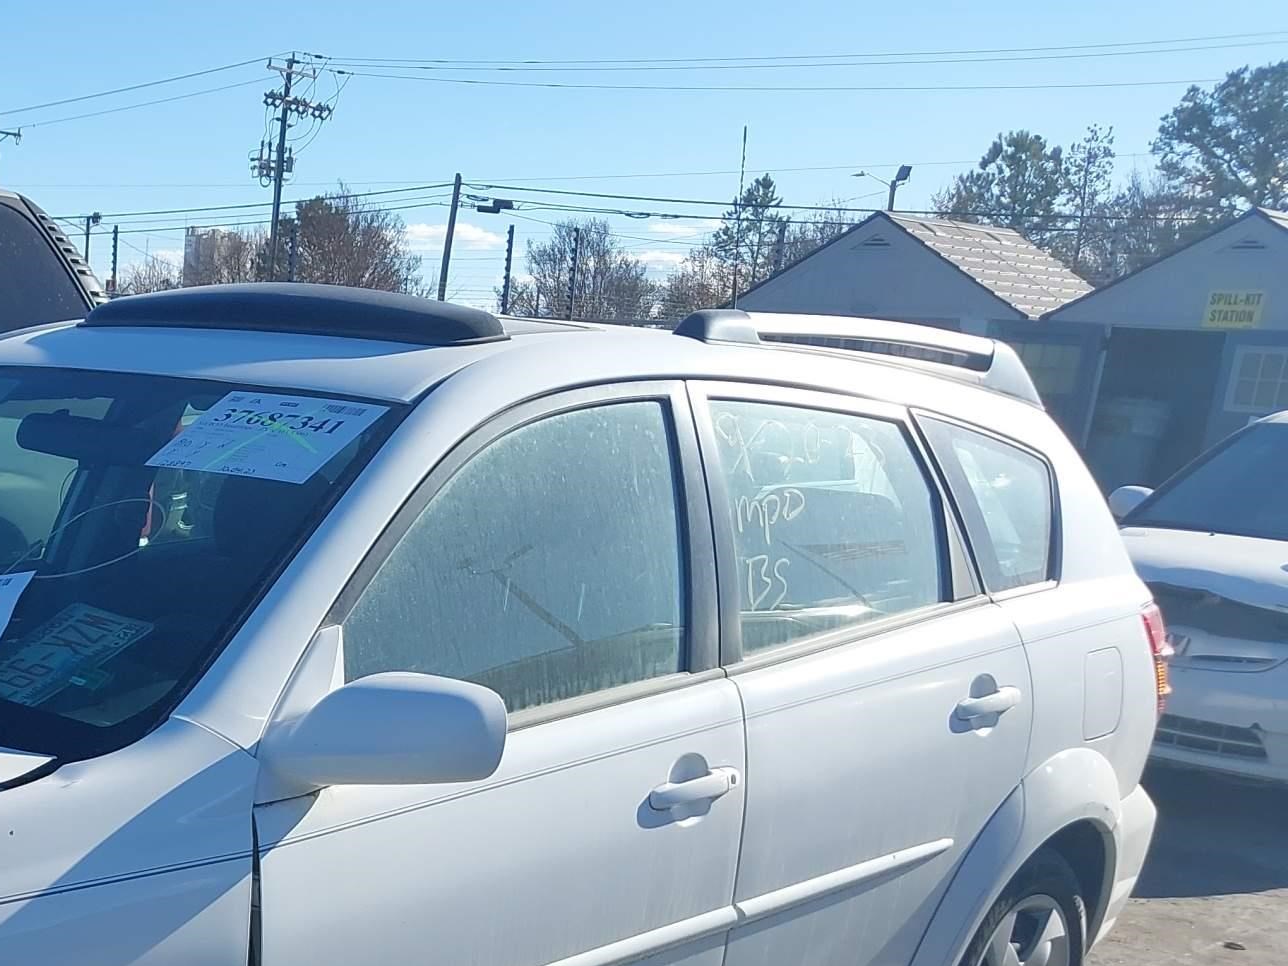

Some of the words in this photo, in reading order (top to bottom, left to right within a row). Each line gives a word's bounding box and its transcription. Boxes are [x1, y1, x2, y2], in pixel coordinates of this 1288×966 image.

[1209, 292, 1264, 306] SPILL-KIT
[1208, 309, 1256, 323] STATION
[213, 407, 345, 435] 37687341
